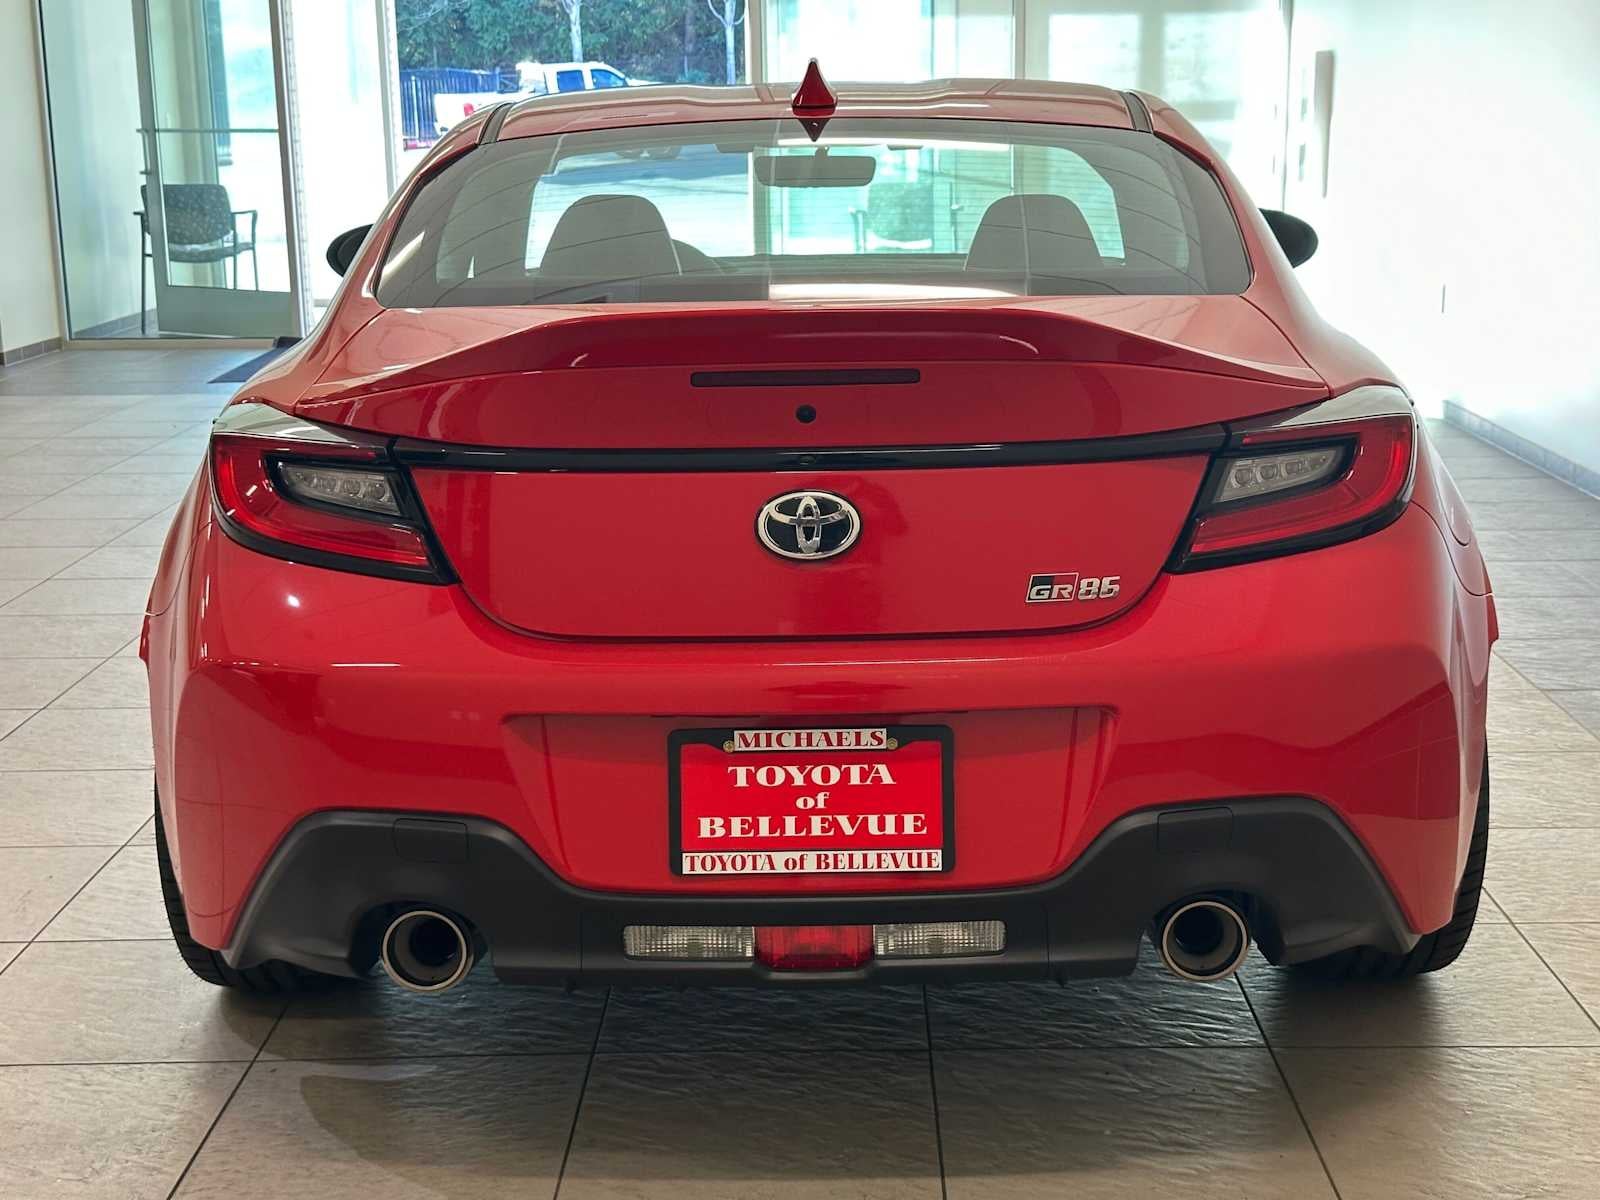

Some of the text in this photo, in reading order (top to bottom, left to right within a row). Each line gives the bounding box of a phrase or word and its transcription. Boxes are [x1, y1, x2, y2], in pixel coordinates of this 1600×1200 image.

[737, 730, 884, 749] MICHAELS
[727, 763, 897, 787] TOYOTA
[795, 791, 830, 810] of
[697, 813, 928, 838] BELLEVUE
[685, 851, 941, 872] TOYOTA of BELLEVUE
